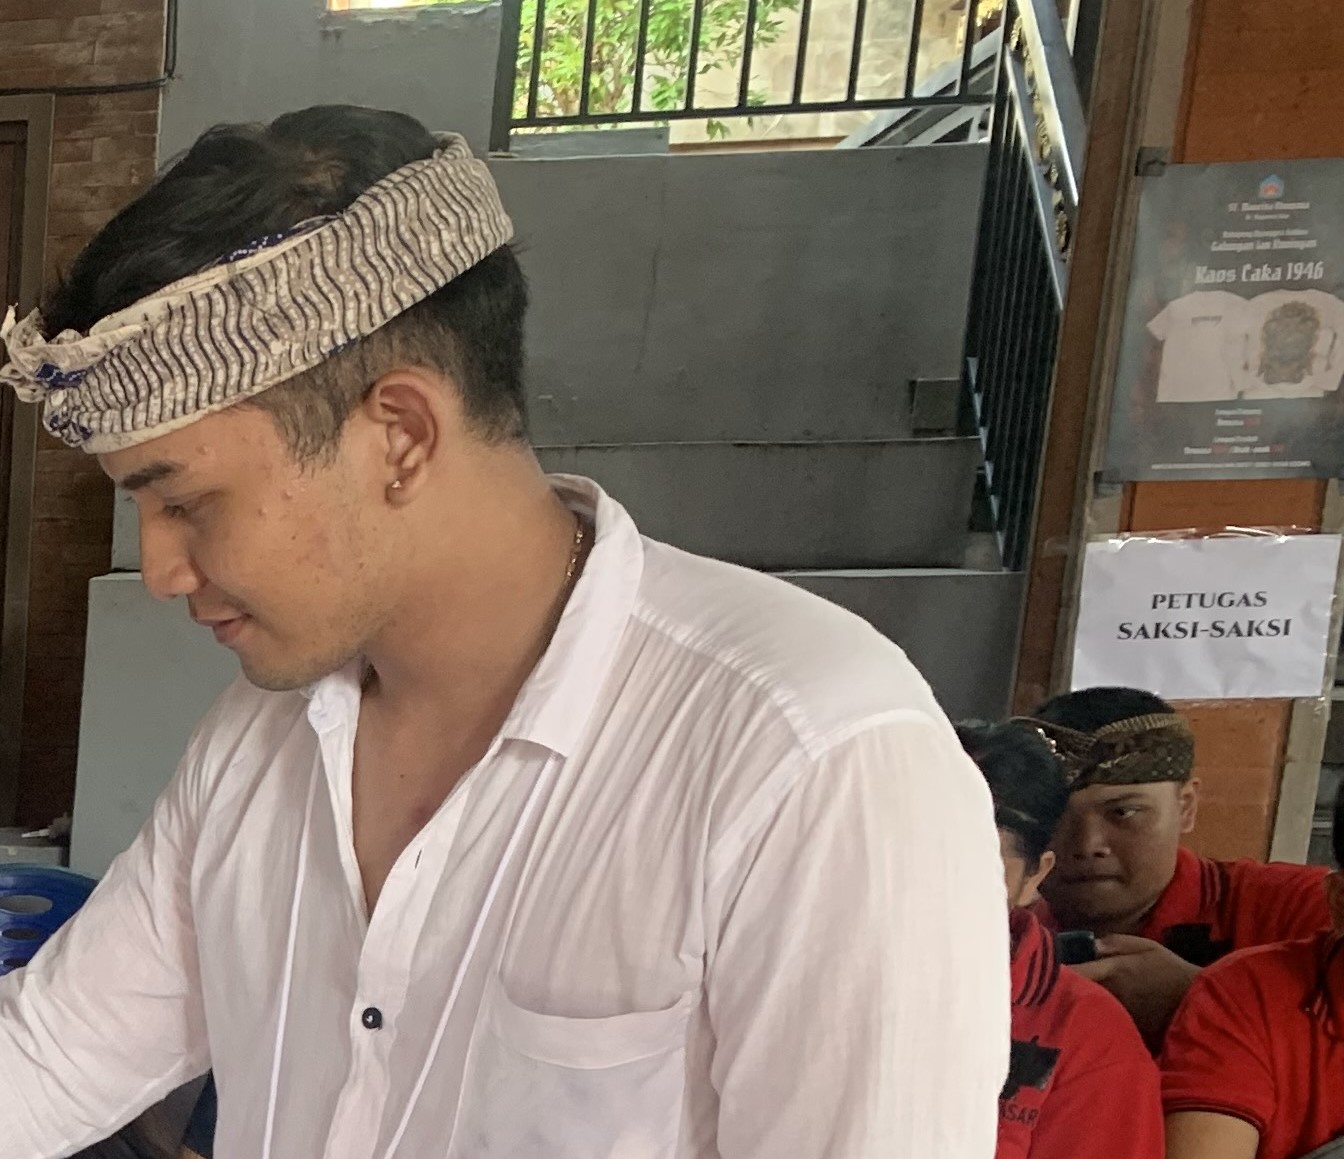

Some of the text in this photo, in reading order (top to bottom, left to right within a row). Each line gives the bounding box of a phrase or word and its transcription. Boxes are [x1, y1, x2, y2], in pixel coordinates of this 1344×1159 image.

[1195, 262, 1324, 284] Kaos Caka 1946
[1151, 591, 1267, 609] PETUGAS
[1116, 619, 1292, 640] SAKSI-SAKSI
